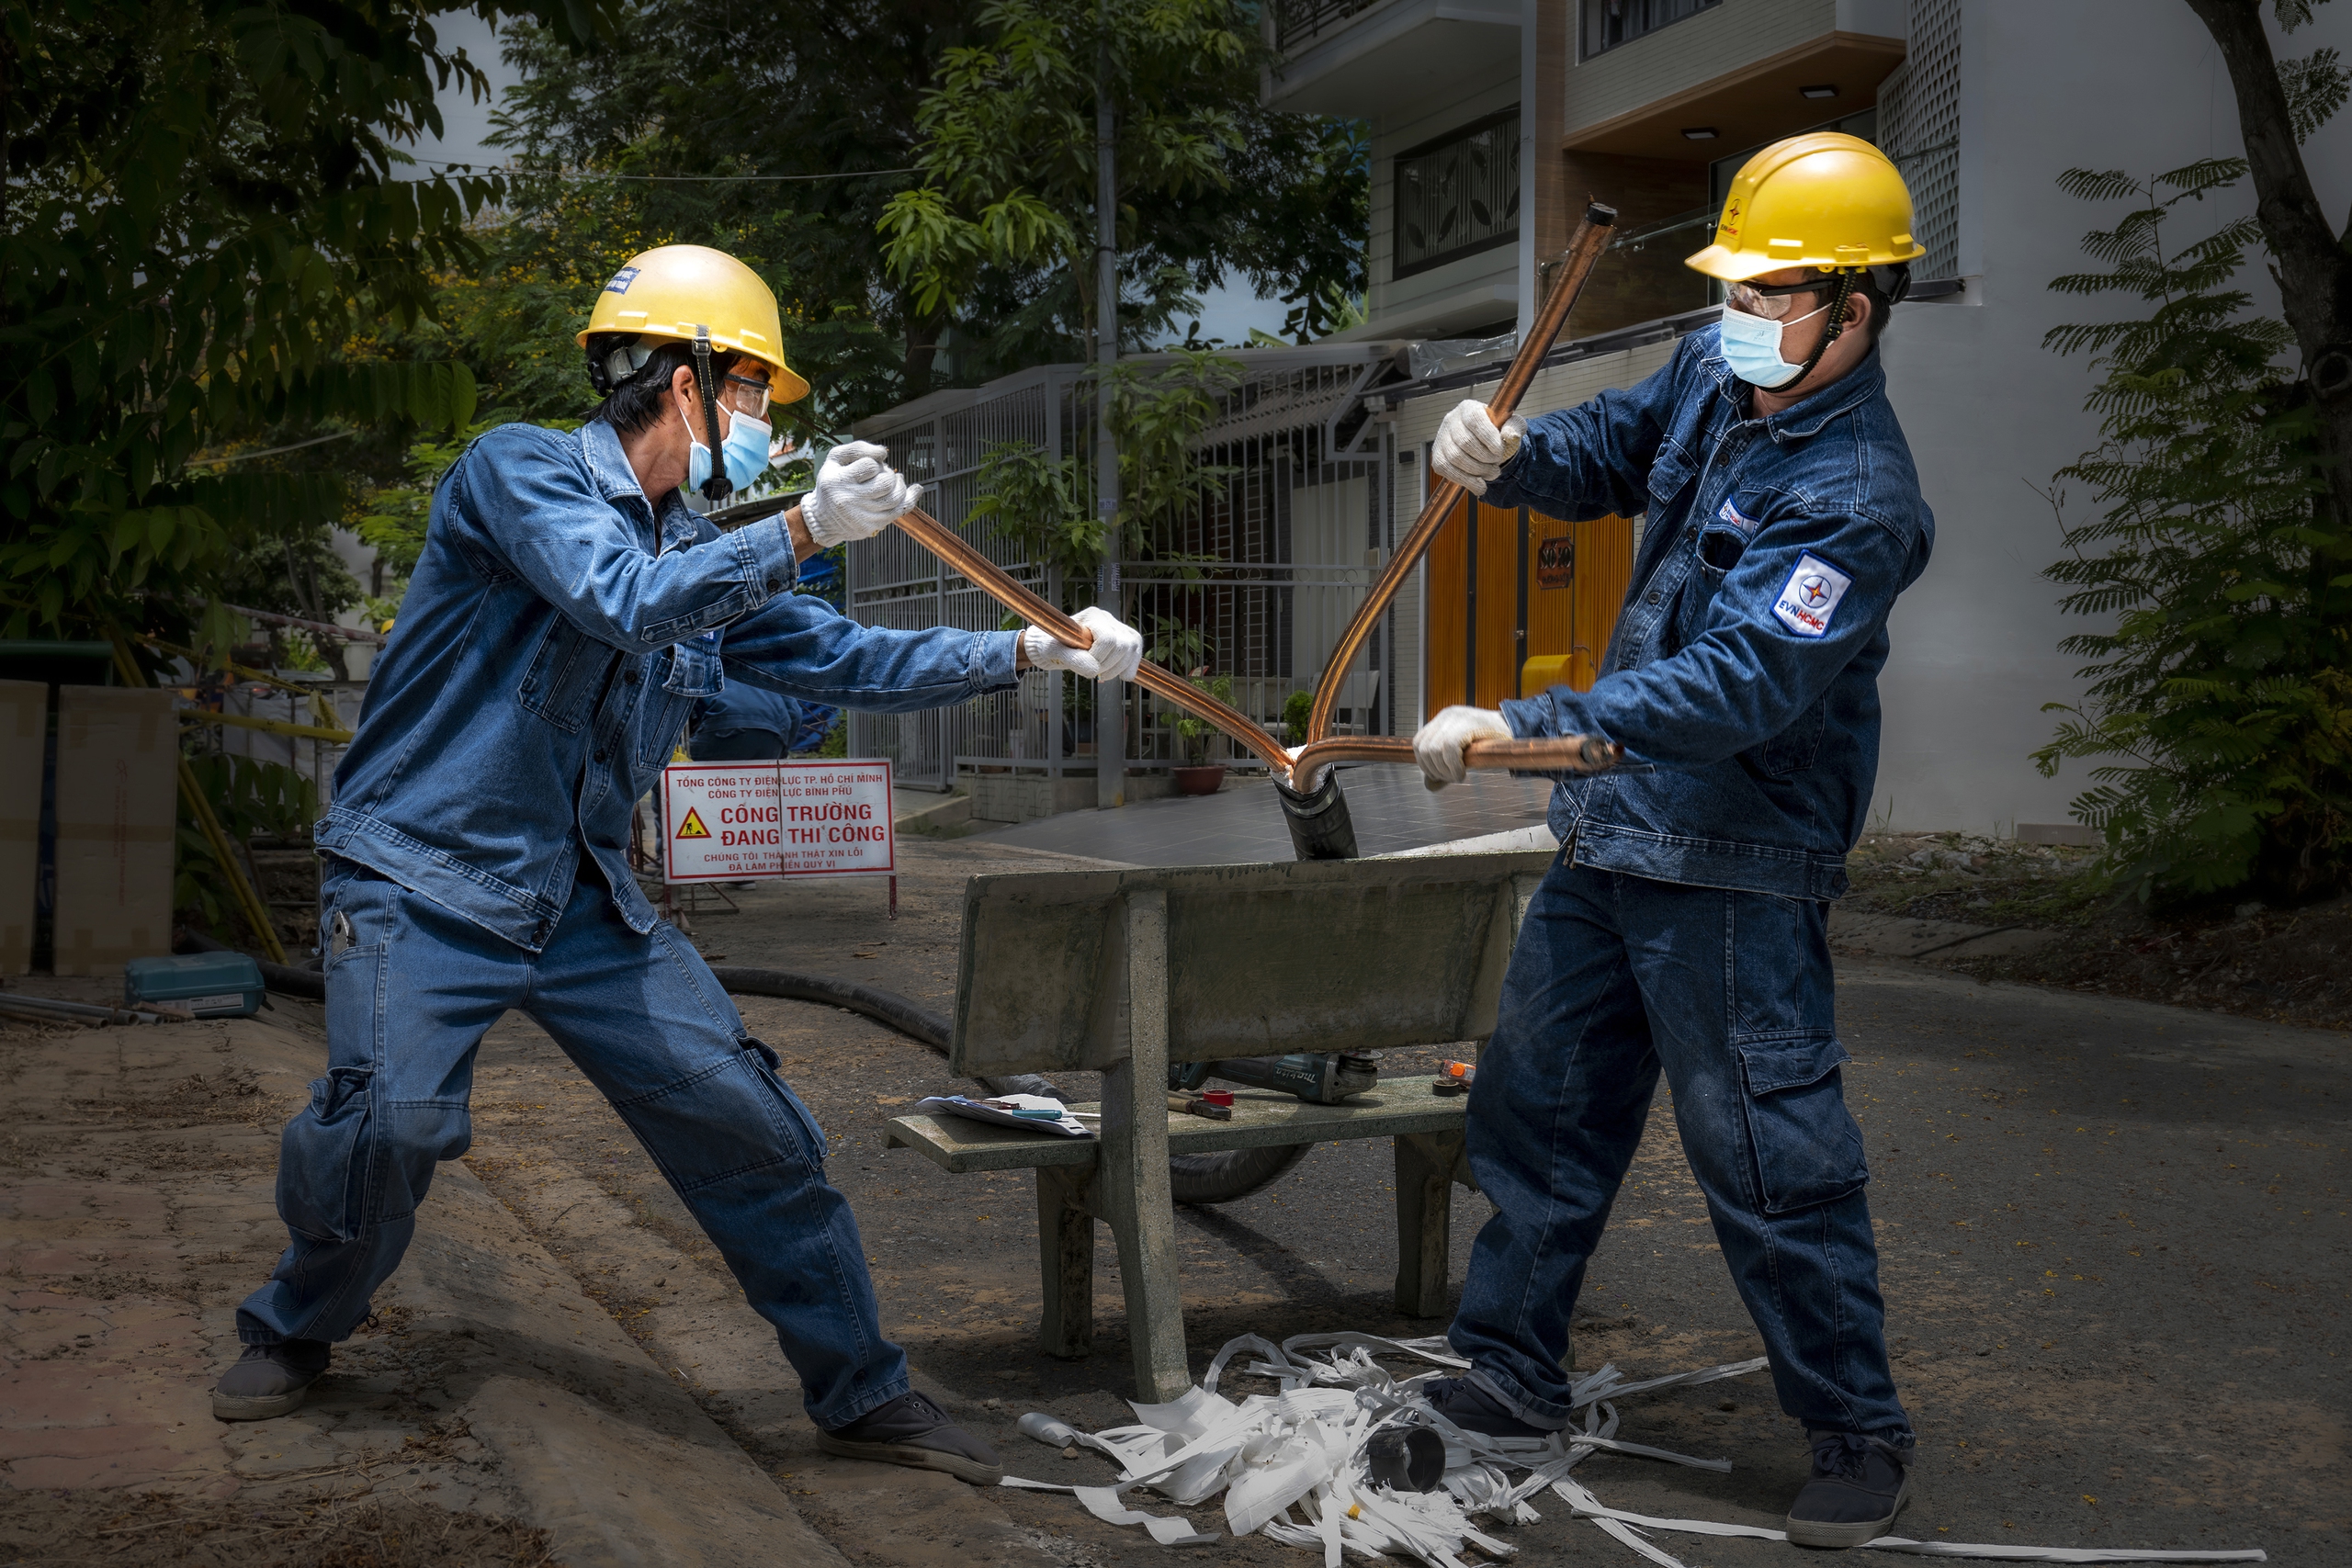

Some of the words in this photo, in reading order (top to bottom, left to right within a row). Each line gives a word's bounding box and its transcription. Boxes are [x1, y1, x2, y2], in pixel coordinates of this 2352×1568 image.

[1778, 600, 1825, 631] EVNHCMC
[676, 775, 705, 787] TỔNG
[707, 776, 736, 786] CÔNG
[739, 777, 752, 785] TY
[754, 775, 778, 786] ĐIỆN
[782, 775, 801, 786] LỰC
[804, 776, 818, 784] TP.
[837, 773, 854, 784] CHÍ
[707, 788, 737, 798] CÔNG
[740, 789, 752, 798] TY
[755, 787, 778, 798] ĐIỆN
[783, 786, 802, 797] LỰC
[805, 786, 829, 796] BÌNH
[720, 803, 779, 825] CÔNG
[786, 802, 872, 822] TRƯỜNG
[720, 829, 780, 846] ĐANG
[787, 828, 820, 844] THI
[828, 823, 885, 843] CÔNG
[704, 852, 739, 862] CHÚNG
[741, 851, 758, 861] TÔI
[763, 850, 798, 860] THÀNH
[801, 849, 825, 860] THẬT
[828, 849, 844, 858] XIN
[847, 846, 864, 857] LỖI
[729, 863, 742, 872] ĐÃ
[745, 862, 766, 871] LÀM
[803, 859, 823, 869] QUÝ
[826, 860, 836, 869] VỊ
